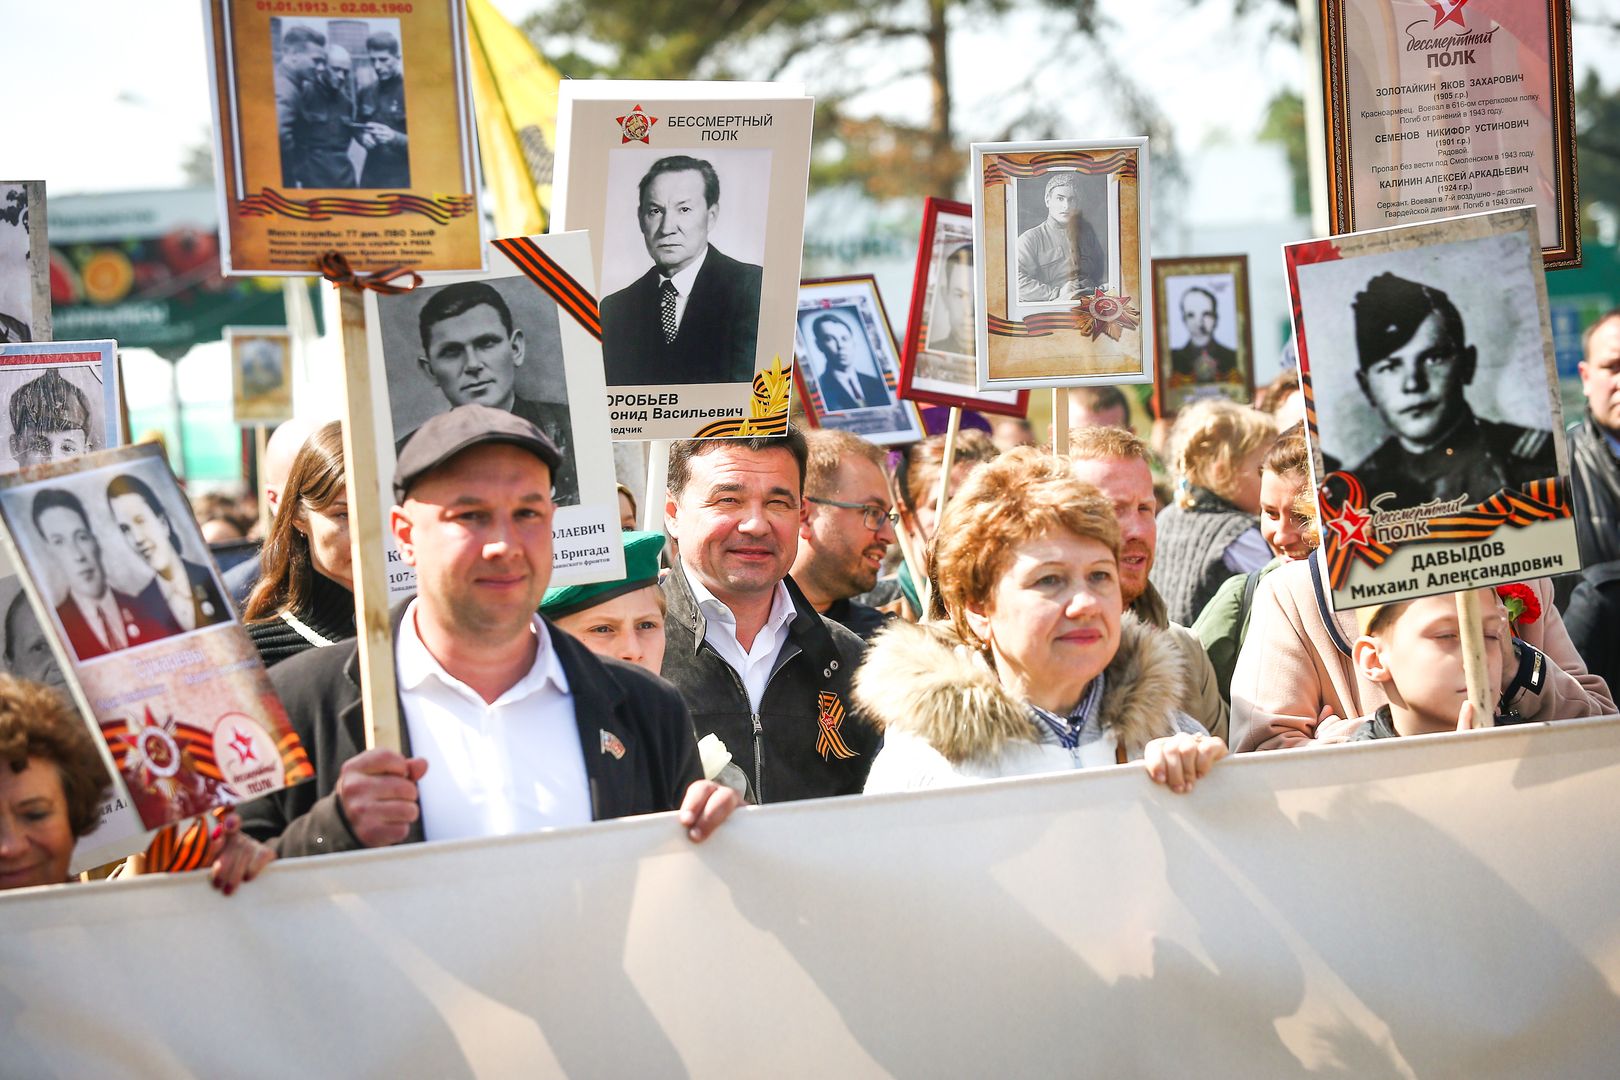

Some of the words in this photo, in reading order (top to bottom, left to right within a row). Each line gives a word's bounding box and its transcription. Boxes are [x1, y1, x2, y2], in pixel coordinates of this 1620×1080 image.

[256, 1, 329, 13] 01.01.1913
[1405, 19, 1500, 52] бессмертный
[1426, 49, 1476, 69] ПОЛК
[1376, 83, 1436, 97] ЗОЛОТАЙКИН
[1441, 80, 1465, 90] ЯКОВ
[1469, 74, 1524, 87] ЗАХАРОВИЧ
[1418, 104, 1444, 113] Воевал
[1451, 101, 1477, 109] 616-ом
[1477, 96, 1518, 106] стрелковом
[1519, 94, 1541, 102] полку.
[1433, 92, 1453, 102] (1905
[1454, 91, 1469, 99] г.р.)
[668, 113, 773, 128] БЕССМЕРТНЫЙ
[1399, 115, 1421, 124] Погиб
[1432, 111, 1462, 122] ранений
[1469, 109, 1486, 117] 1943
[1487, 108, 1504, 116] году.
[701, 130, 739, 141] ПОЛК
[1374, 131, 1420, 143] СЕМЕНОВ
[1426, 126, 1471, 138] НИКИФОР
[1475, 119, 1529, 133] УСТИНОВИЧ
[1435, 138, 1454, 148] (1901
[1456, 137, 1471, 146] г.р.)
[1371, 165, 1399, 174] Пропал
[1449, 155, 1493, 165] Смоленском
[1501, 151, 1518, 159] 1943
[1518, 150, 1535, 158] году.
[1379, 177, 1423, 189] КАЛИНИН
[1424, 171, 1467, 184] АЛЕКСЕЙ
[1468, 165, 1529, 180] АРКАДЬЕВИЧ
[1376, 200, 1409, 210] Сержант.
[1410, 197, 1437, 206] Воевал
[1456, 191, 1491, 200] воздушно
[1496, 186, 1533, 197] десантной
[1437, 184, 1457, 194] (1924
[1458, 183, 1473, 191] г.р.)
[1384, 207, 1429, 218] Гвардейской
[1430, 205, 1461, 214] дивизии.
[1463, 201, 1484, 209] Погиб
[1492, 198, 1509, 206] 1943
[610, 410, 648, 422] онид
[652, 407, 743, 419] Васильевич
[1377, 520, 1429, 542] ПОЛК
[561, 546, 610, 561] Бригада
[1411, 541, 1505, 573] ДАВЫДОВ
[1350, 578, 1419, 600] Михаил
[1426, 554, 1563, 588] Александрович
